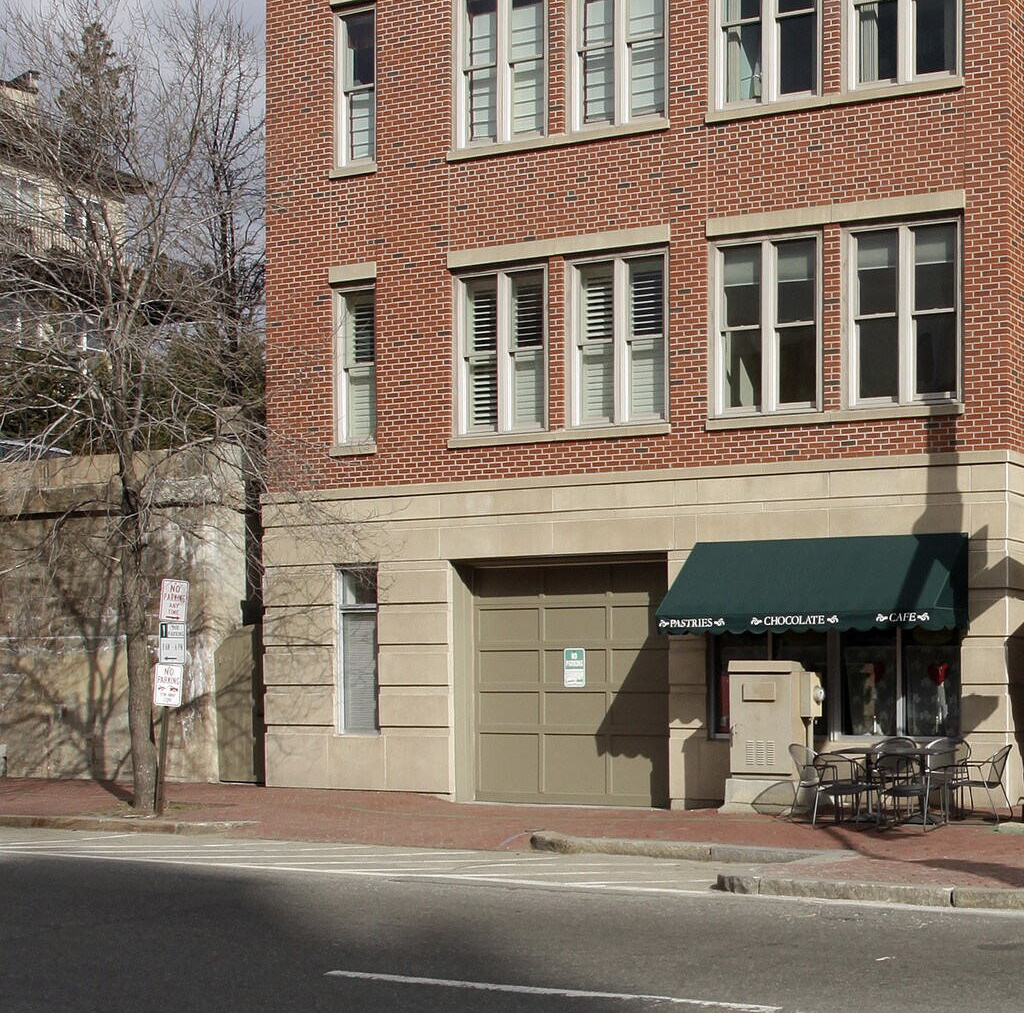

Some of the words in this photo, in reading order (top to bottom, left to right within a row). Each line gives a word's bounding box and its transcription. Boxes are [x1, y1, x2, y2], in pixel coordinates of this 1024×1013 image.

[170, 584, 181, 593] NO
[163, 593, 186, 604] PARKING
[669, 617, 713, 629] PASTRIES
[763, 615, 826, 627] CHOCOLATE
[888, 612, 917, 623] CAFE
[164, 667, 175, 676] NO
[157, 676, 180, 685] PARKING
